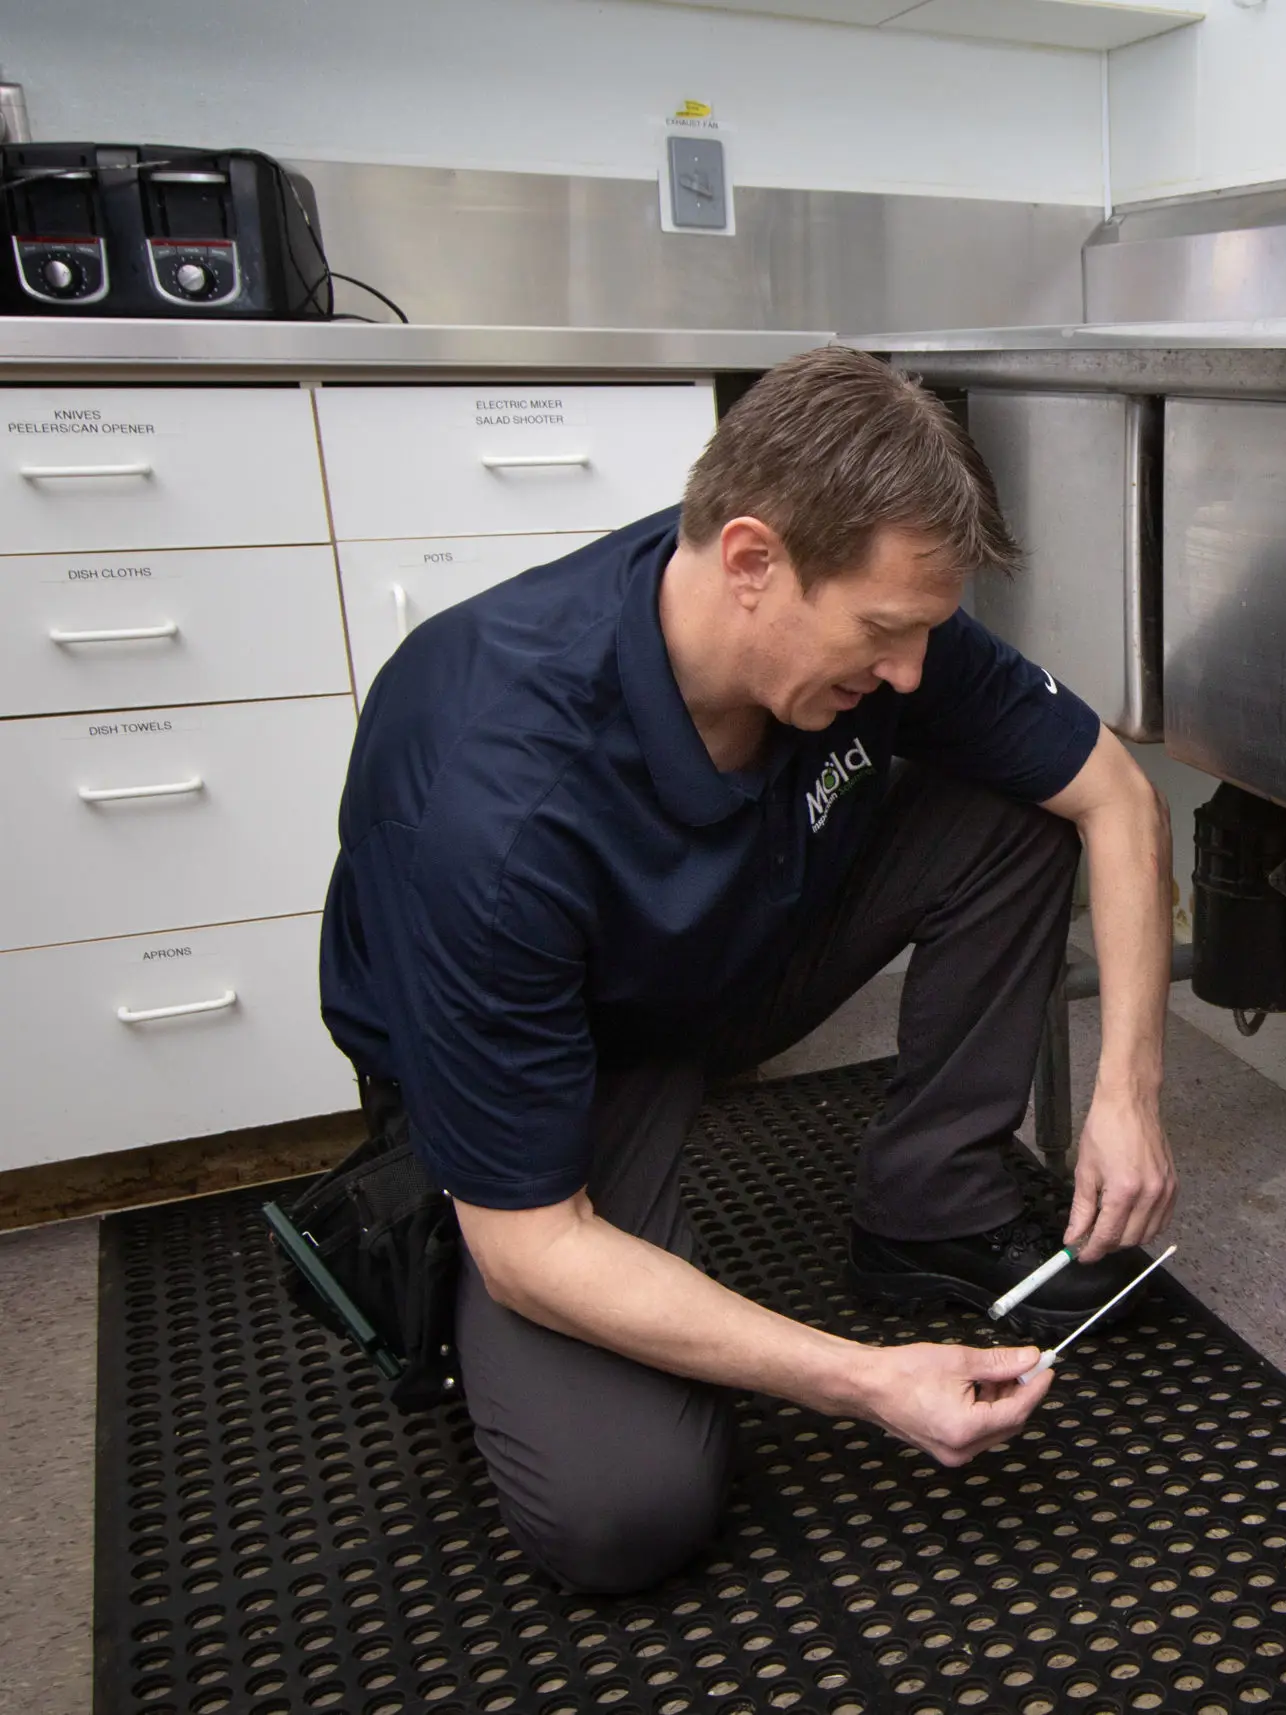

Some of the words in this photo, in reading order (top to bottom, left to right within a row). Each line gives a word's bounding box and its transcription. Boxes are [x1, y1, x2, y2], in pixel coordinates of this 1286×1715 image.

[476, 399, 528, 410] ELECTRIC
[530, 399, 563, 409] MIXER
[54, 410, 102, 420] KNIVES
[475, 415, 511, 425] SALAD
[512, 415, 564, 424] SHOOTER
[8, 423, 99, 434] PEELERS/CAN
[101, 423, 155, 434] OPENER
[423, 552, 454, 563] POTS
[68, 569, 99, 580] DISH
[101, 567, 152, 578] CLOTHS
[88, 725, 118, 736] DISH
[121, 721, 172, 733] TOWELS
[143, 946, 193, 961] APRONS
